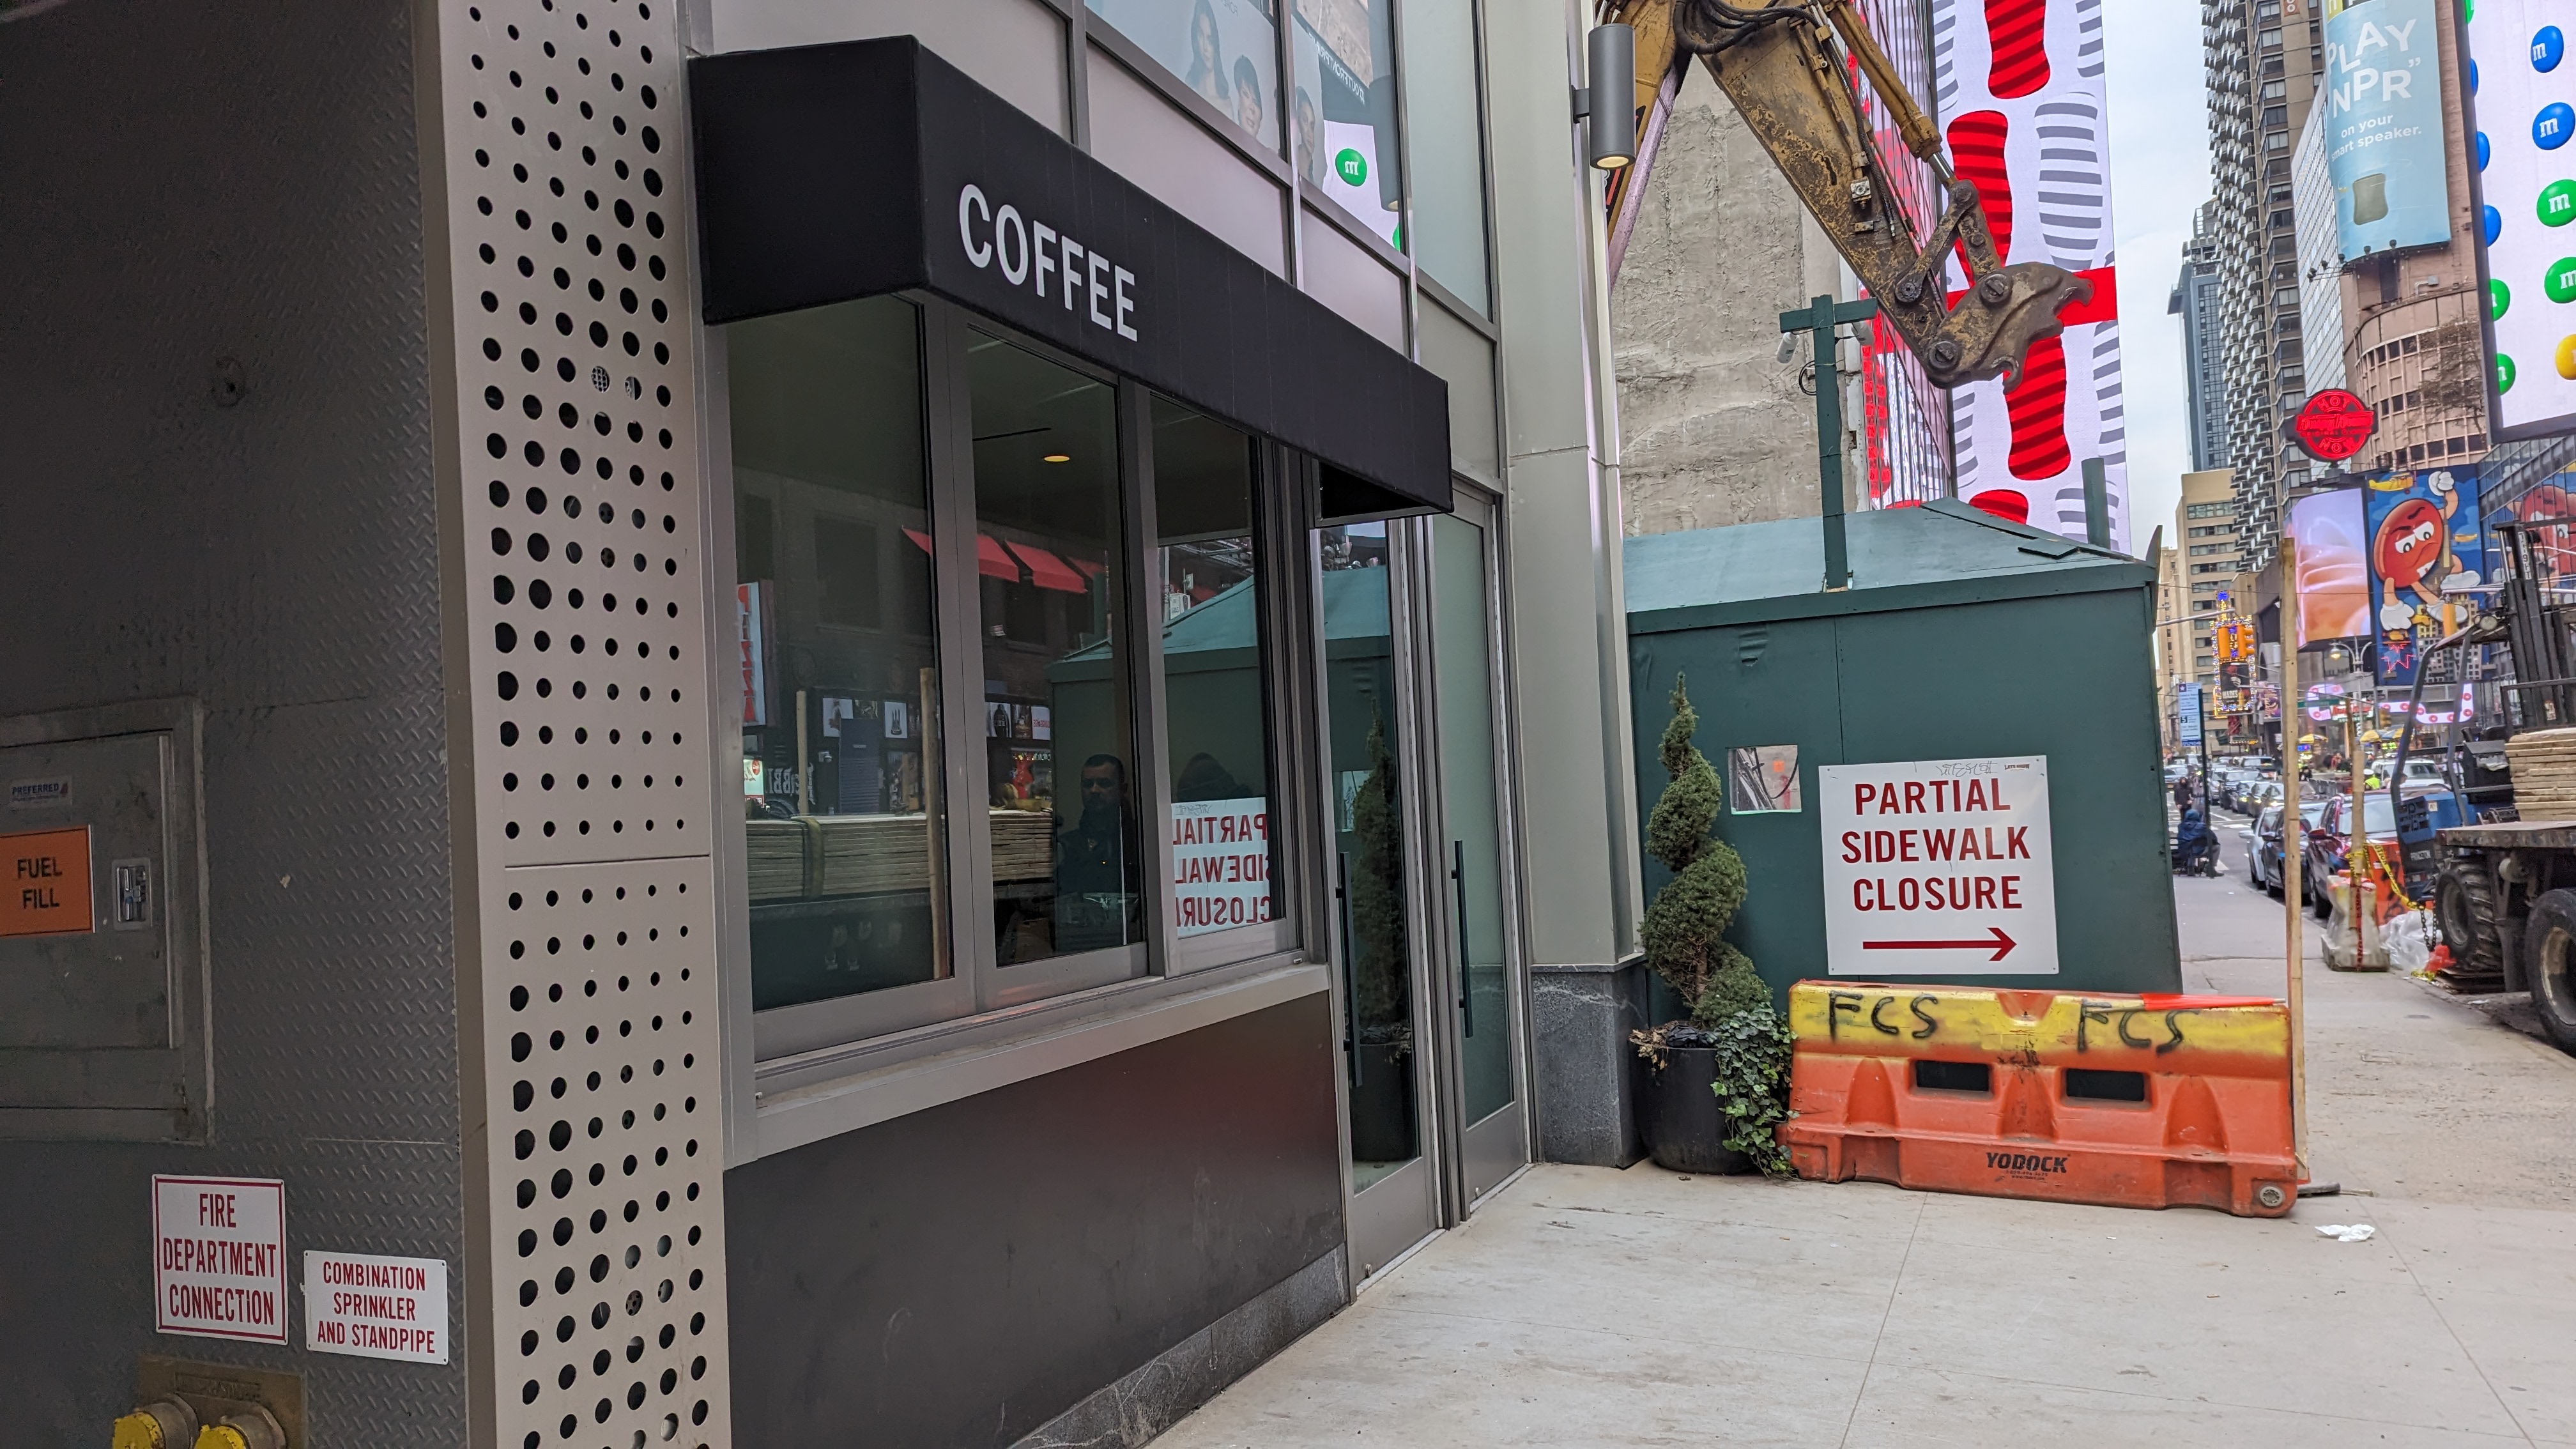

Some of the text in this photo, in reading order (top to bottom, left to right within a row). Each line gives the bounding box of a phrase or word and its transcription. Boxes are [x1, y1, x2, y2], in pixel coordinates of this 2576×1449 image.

[2326, 19, 2417, 76] PLAY
[2532, 43, 2547, 61] m
[2341, 115, 2393, 139] on your
[2358, 126, 2421, 148] speaker.
[2539, 118, 2559, 138] m
[2548, 194, 2571, 214] m
[959, 184, 1137, 342] COFFEE
[2317, 395, 2350, 411] HOT
[2319, 437, 2356, 454] NOW
[12, 783, 59, 795] PREFERRED
[1855, 778, 2011, 816] PARTIAL
[1841, 825, 2030, 864] SIDEWALK
[17, 857, 63, 880] FUEL
[22, 888, 59, 910] FILL
[1853, 875, 2022, 912] CLOSURE
[1828, 991, 1938, 1043] FCS
[2078, 999, 2200, 1055] FCS
[1986, 1152, 2067, 1173] YODOCK
[199, 1193, 236, 1229] FIRE
[163, 1237, 277, 1278] DEPARTMENT
[323, 1261, 425, 1291] COMBINATION
[169, 1284, 274, 1326] CONNECTION
[334, 1292, 416, 1321] SPRINKLER
[318, 1321, 435, 1354] AND STANDPIPE
